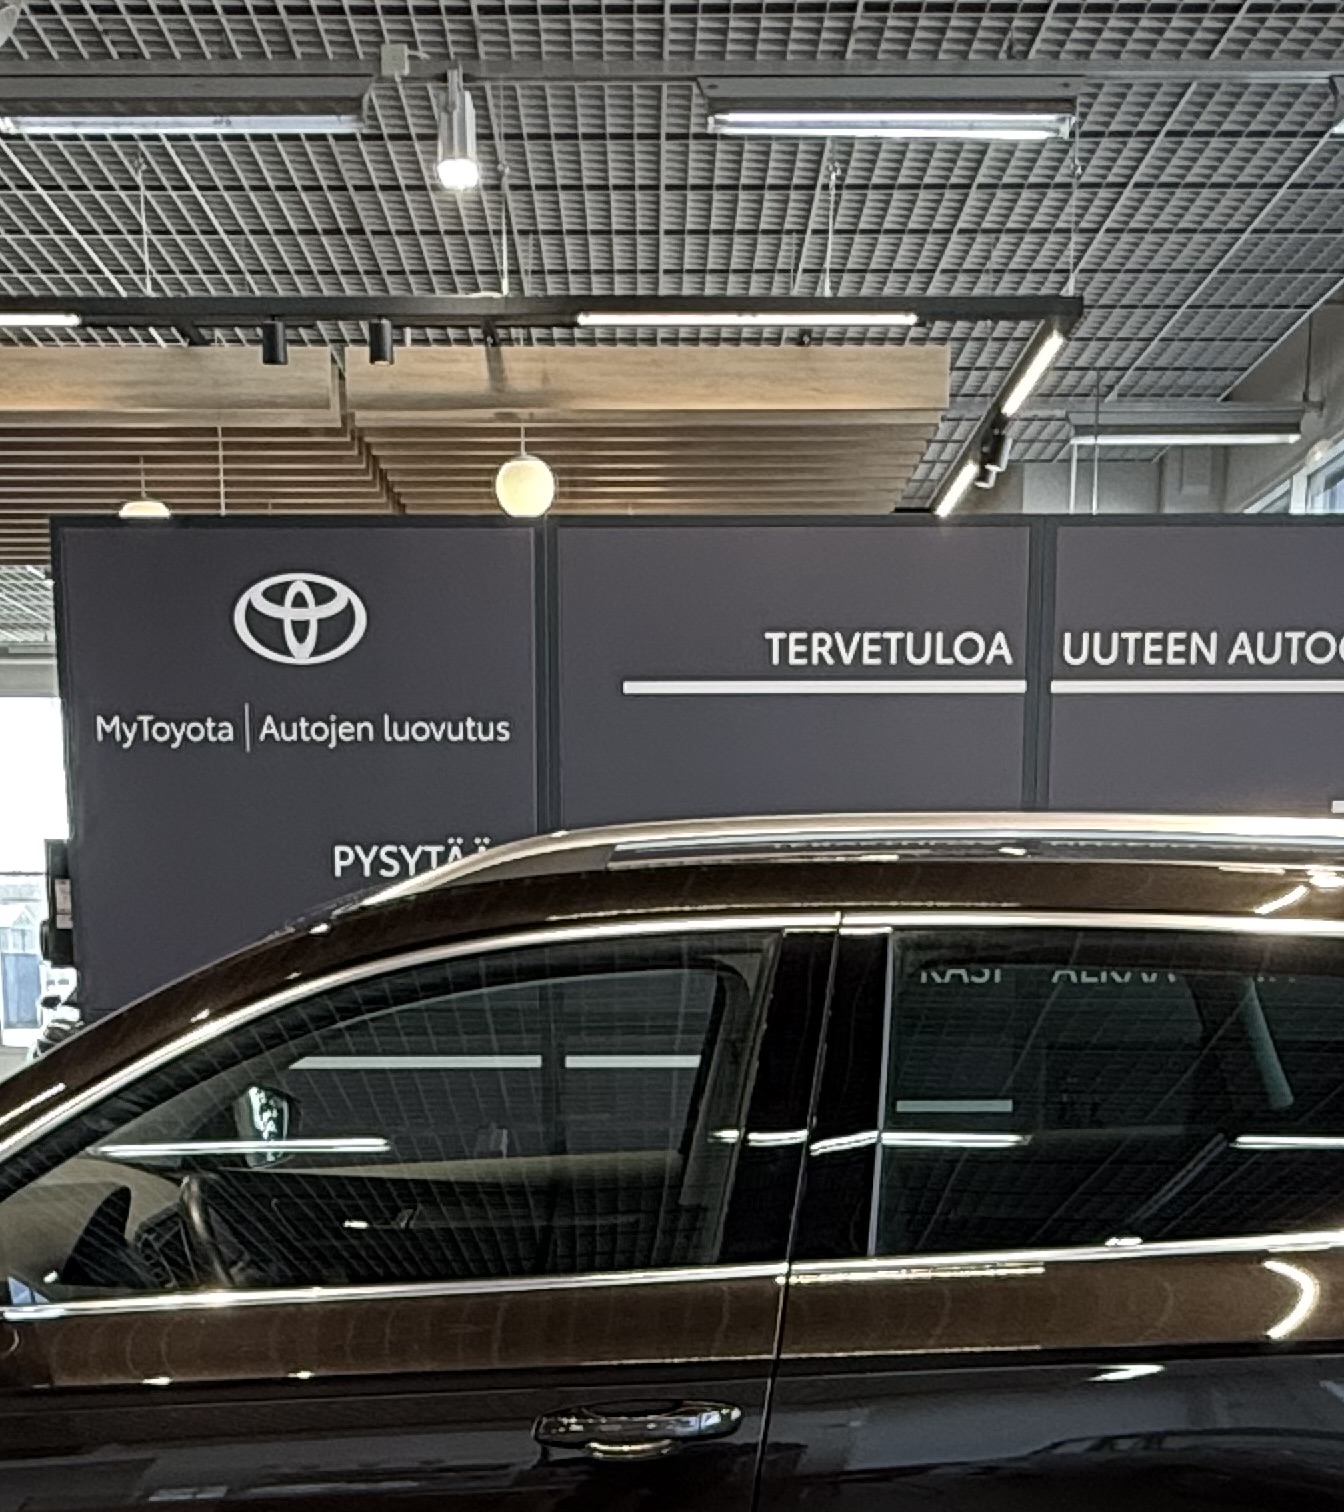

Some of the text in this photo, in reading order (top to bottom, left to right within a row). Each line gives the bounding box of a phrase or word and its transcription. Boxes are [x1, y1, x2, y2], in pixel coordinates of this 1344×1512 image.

[765, 631, 1013, 665] TERVETULOA
[1063, 631, 1217, 665] UUTEEN
[96, 713, 511, 749] MyToyota Autojen luovutus
